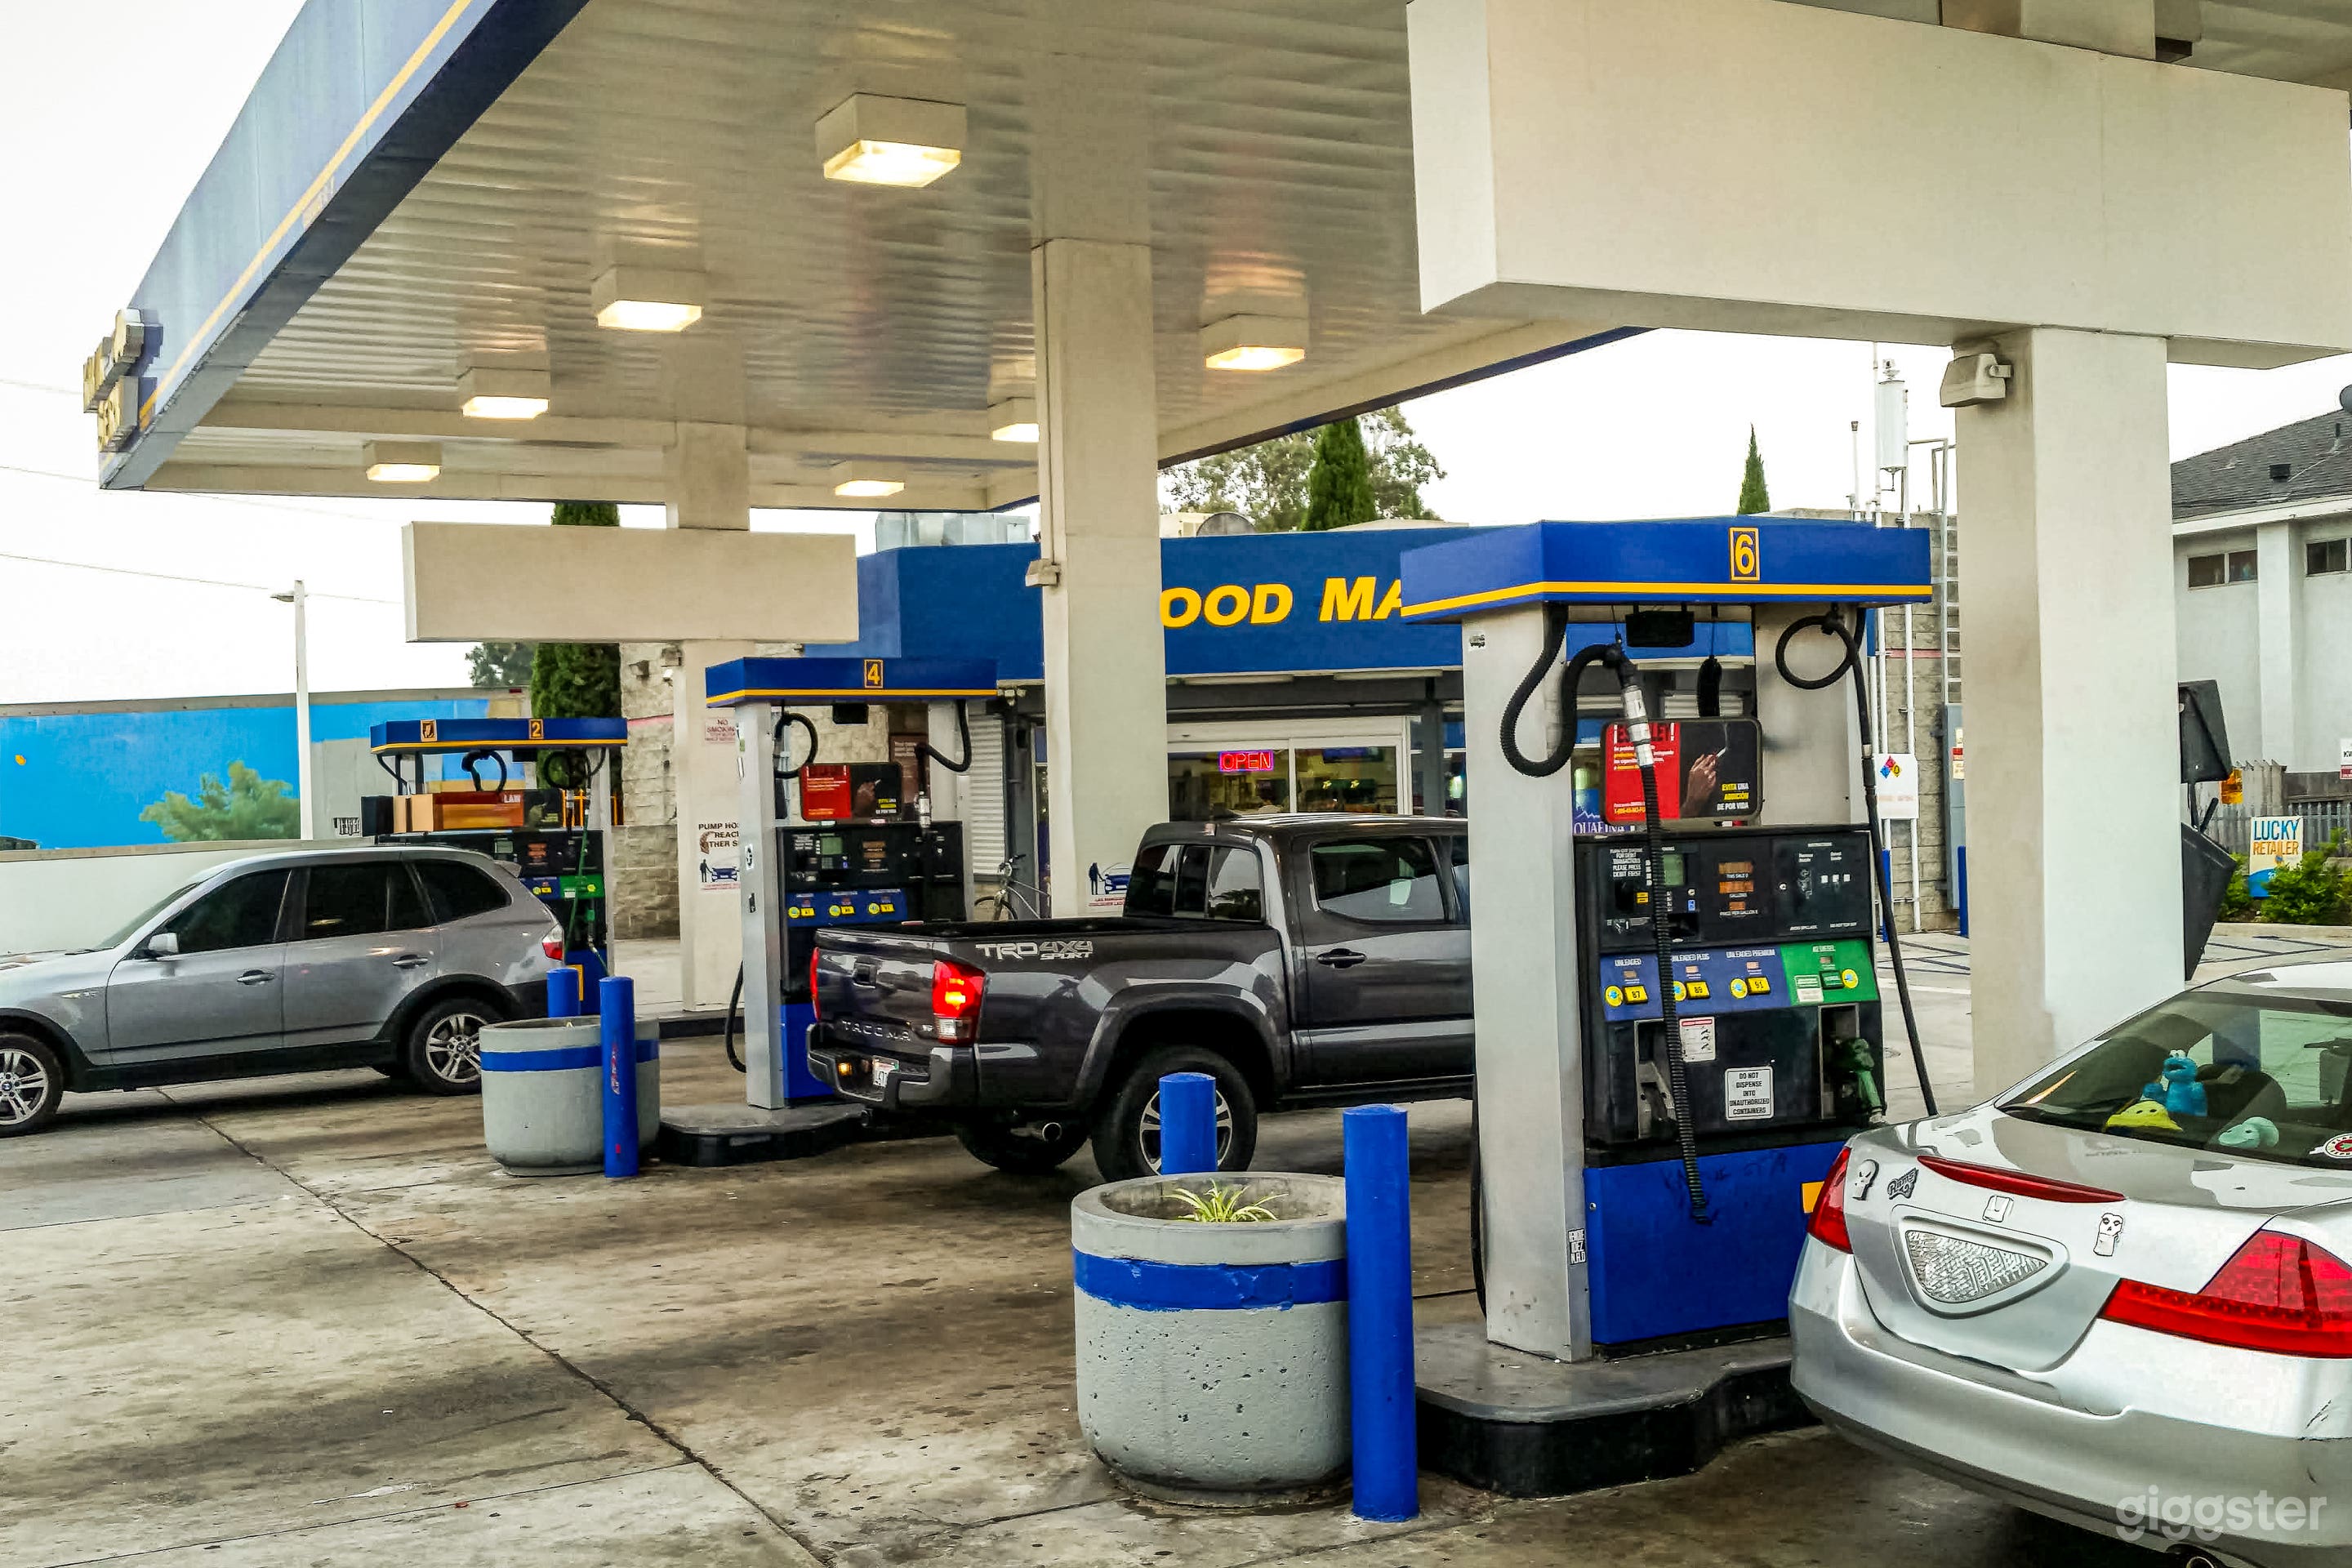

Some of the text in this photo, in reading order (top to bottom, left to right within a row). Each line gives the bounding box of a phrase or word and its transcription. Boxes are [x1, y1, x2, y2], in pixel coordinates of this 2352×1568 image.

[1735, 533, 1754, 575] 6
[1160, 576, 1401, 629] OOD MA
[868, 663, 880, 685] 4
[532, 721, 541, 737] 2
[1223, 752, 1271, 770] OPEN
[698, 822, 724, 831] PUMP
[1573, 822, 1625, 835] QUAFINA
[2253, 820, 2300, 840] LUCKY
[2252, 841, 2300, 855] RETAILER
[975, 942, 1039, 960] TRD
[1040, 951, 1093, 960] SPORT
[1726, 950, 1752, 959] UNLEADED
[1615, 958, 1642, 967] UNLEADED
[841, 1019, 911, 1042] TACOMA
[1735, 1080, 1762, 1089] DISPENSE
[1729, 1098, 1770, 1107] UNAUTHORIZED
[1733, 1107, 1766, 1116] CONTAINERS
